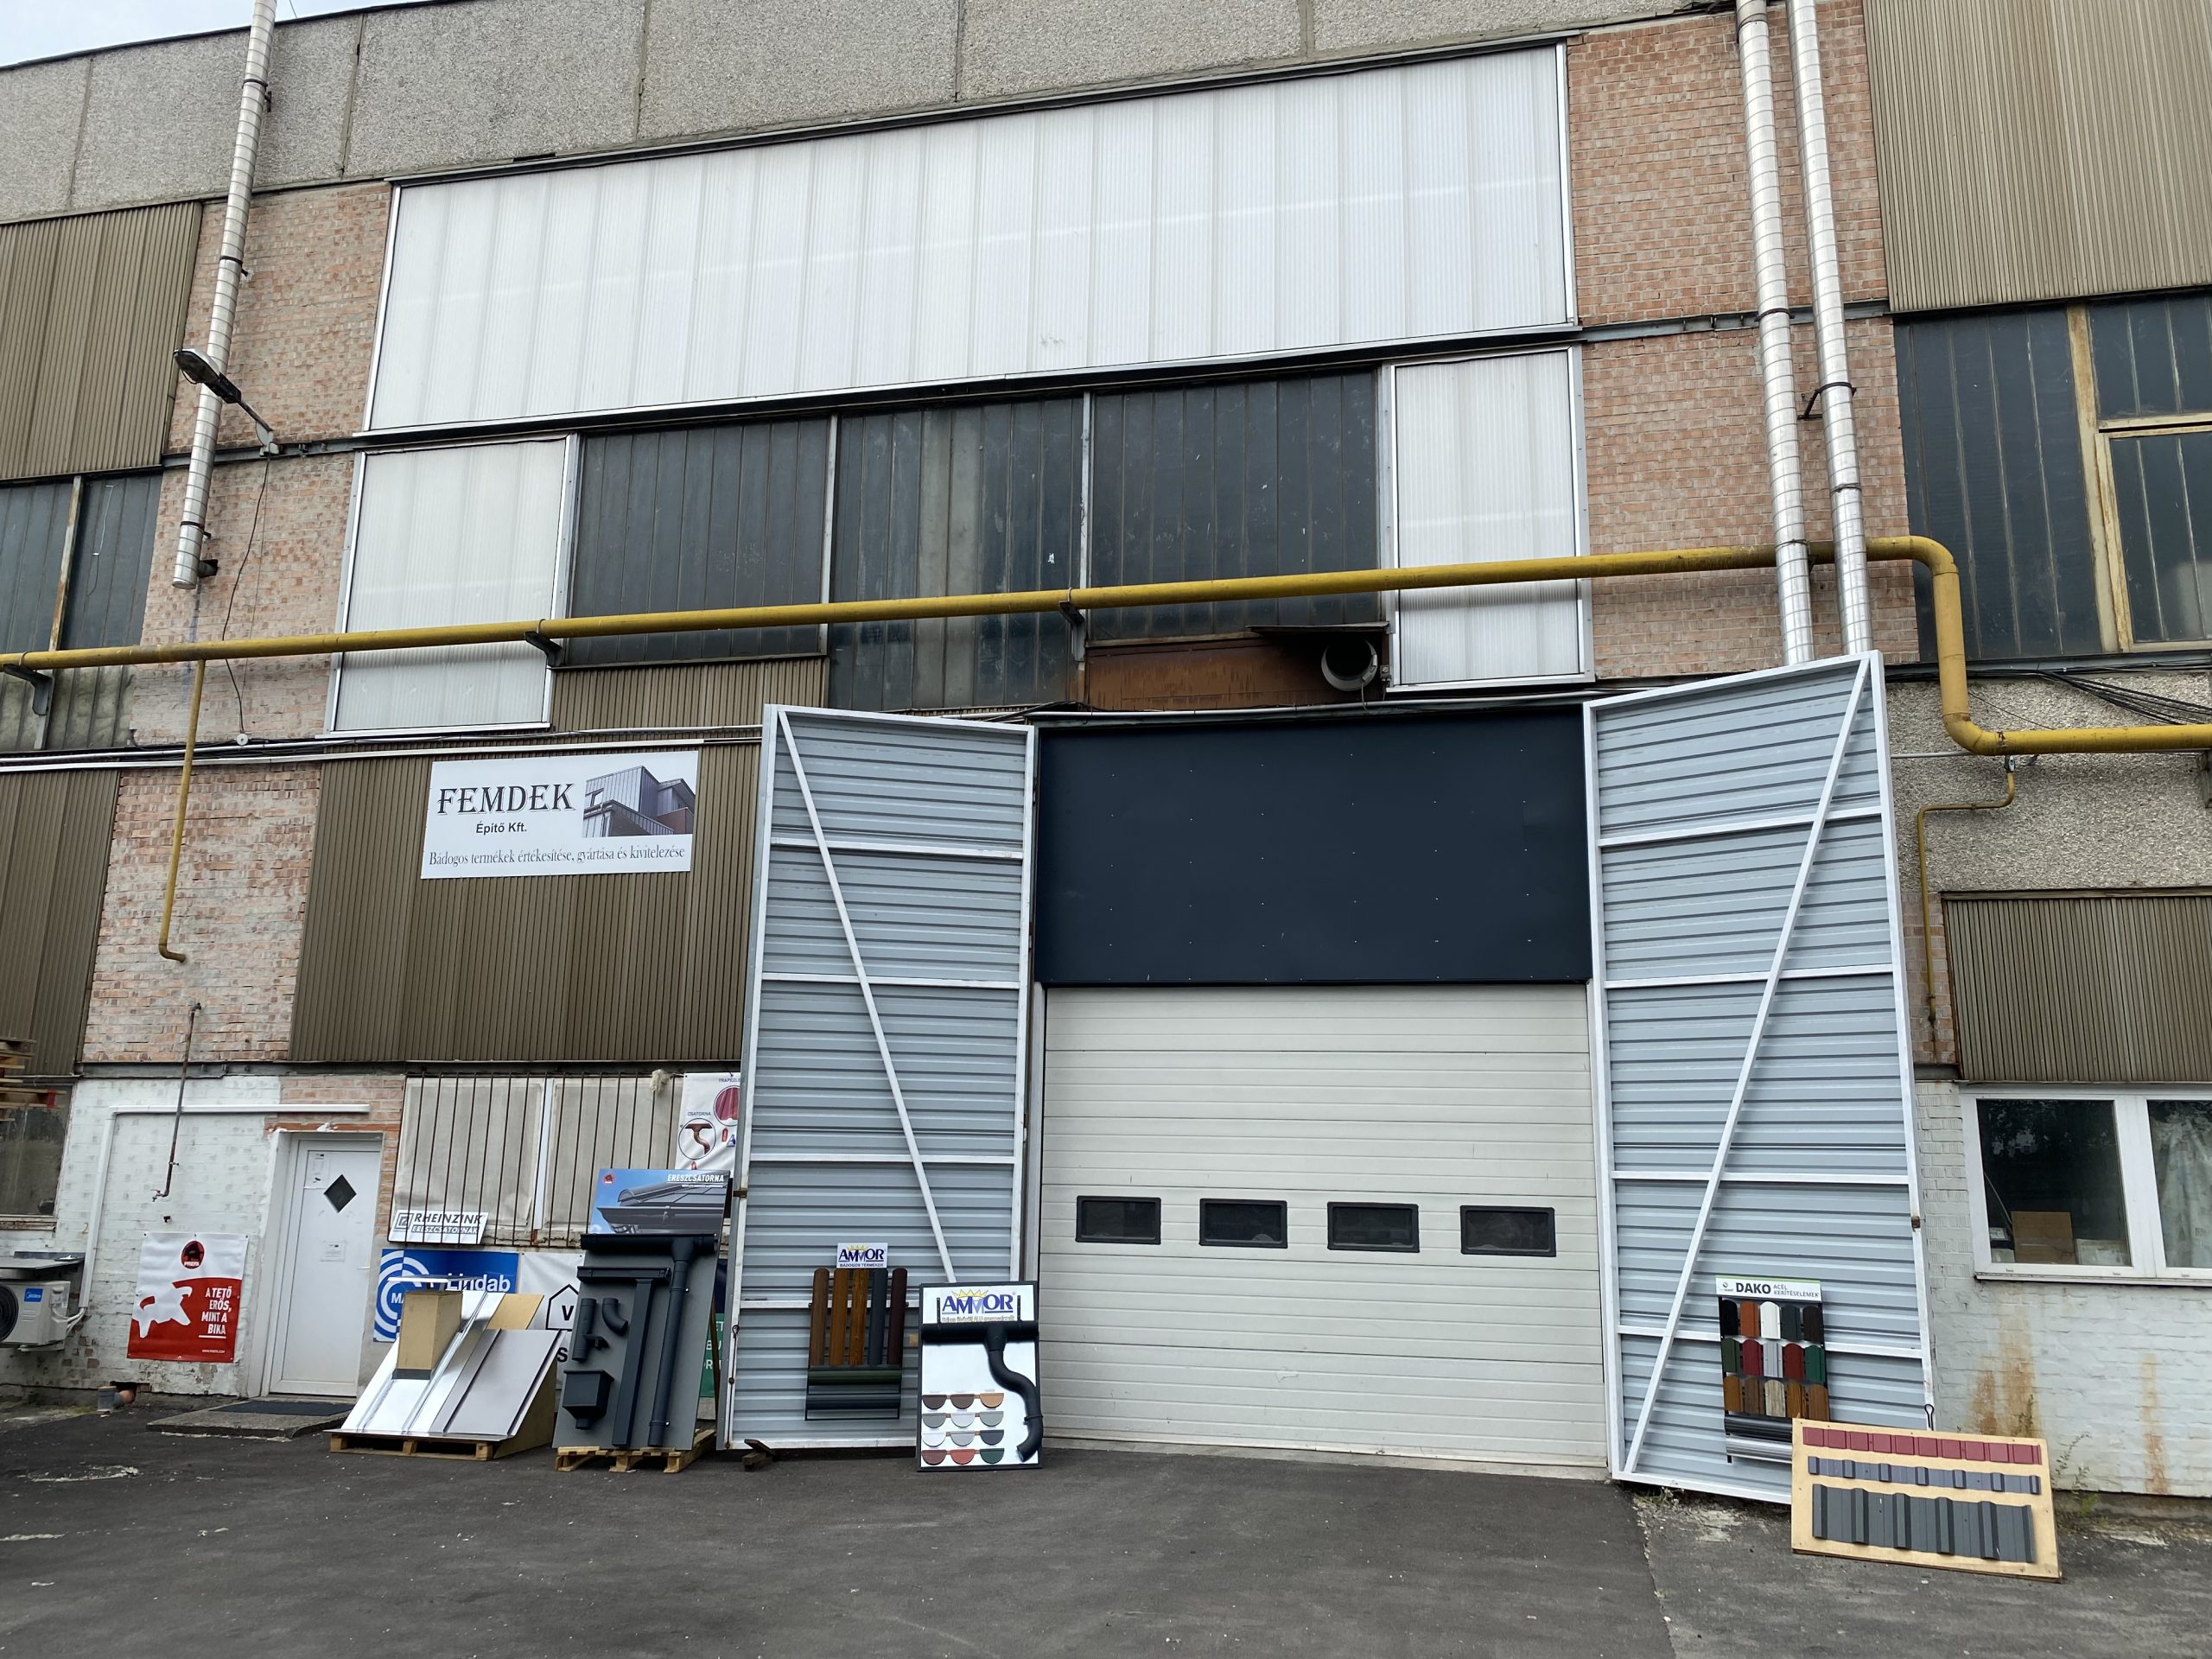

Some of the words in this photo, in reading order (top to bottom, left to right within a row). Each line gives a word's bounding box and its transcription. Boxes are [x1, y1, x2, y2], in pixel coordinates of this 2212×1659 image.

[437, 783, 575, 815] FEMDEK
[476, 821, 505, 836] Építő
[508, 822, 527, 833] Kft.
[429, 851, 468, 867] Bádogos
[471, 849, 515, 863] termékek
[518, 848, 575, 862] értékesítése,
[577, 847, 614, 863] gyártása
[617, 846, 627, 859] és
[630, 844, 685, 859] kivitelezése
[667, 1173, 724, 1182] ERESZCSATORNA
[205, 1287, 211, 1298] A
[212, 1286, 232, 1300] TETŐ
[1736, 1282, 1771, 1294] DAKO
[209, 1298, 232, 1312] ERŐS,
[201, 1312, 220, 1322] MINT
[220, 1313, 227, 1323] A
[207, 1324, 226, 1335] BIKA
